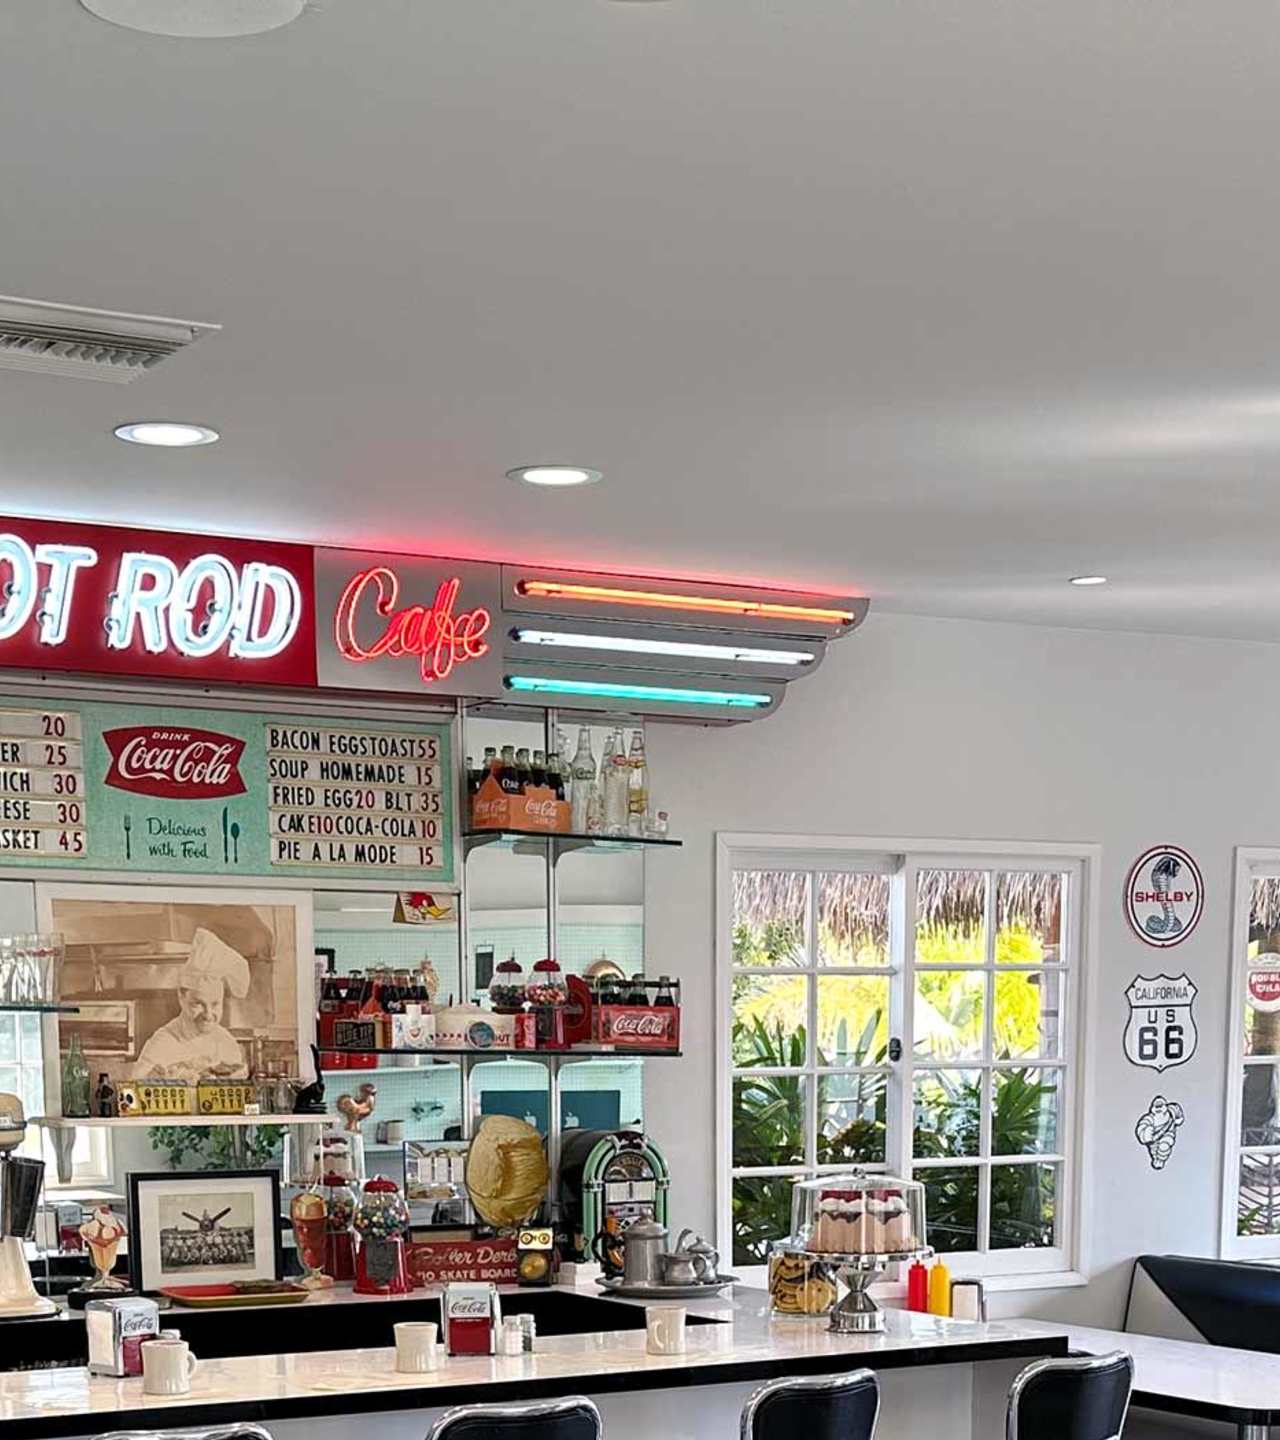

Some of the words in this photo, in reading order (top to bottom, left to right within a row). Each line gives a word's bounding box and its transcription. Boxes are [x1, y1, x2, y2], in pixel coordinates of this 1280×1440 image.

[104, 552, 302, 659] ROD
[336, 567, 490, 681] Cafe
[42, 715, 65, 737] 20
[152, 731, 192, 741] DRINK
[270, 729, 320, 750] BACON
[45, 744, 67, 766] 25
[118, 736, 236, 785] Coca-Cola
[270, 759, 309, 779] SOUP
[320, 761, 406, 784] HOMEMADE
[416, 766, 433, 785] 15
[54, 774, 77, 794] 30
[273, 786, 315, 806] FRIED
[324, 789, 353, 808] EGG
[355, 790, 375, 809] 20
[385, 791, 413, 811] BLT
[421, 793, 439, 812] 35
[58, 803, 80, 824] 30
[146, 817, 207, 837] Delicious
[278, 814, 316, 834] CAKE
[316, 815, 333, 834] 10
[336, 816, 416, 838] COCA-COLA
[421, 820, 436, 838] 10
[59, 831, 83, 852] 45
[149, 843, 177, 858] with
[180, 841, 208, 858] Food
[278, 841, 300, 860] PIE
[312, 842, 321, 861] A
[329, 843, 347, 862] LA
[354, 844, 397, 864] MODE
[419, 847, 434, 865] 15
[1135, 891, 1194, 903] SHELBY
[1135, 986, 1188, 1001] CALIFORNIA
[613, 1015, 664, 1035] Coca-Cola
[1138, 1025, 1184, 1060] 66
[477, 1246, 517, 1263] Derb
[440, 1269, 476, 1280] SKATE
